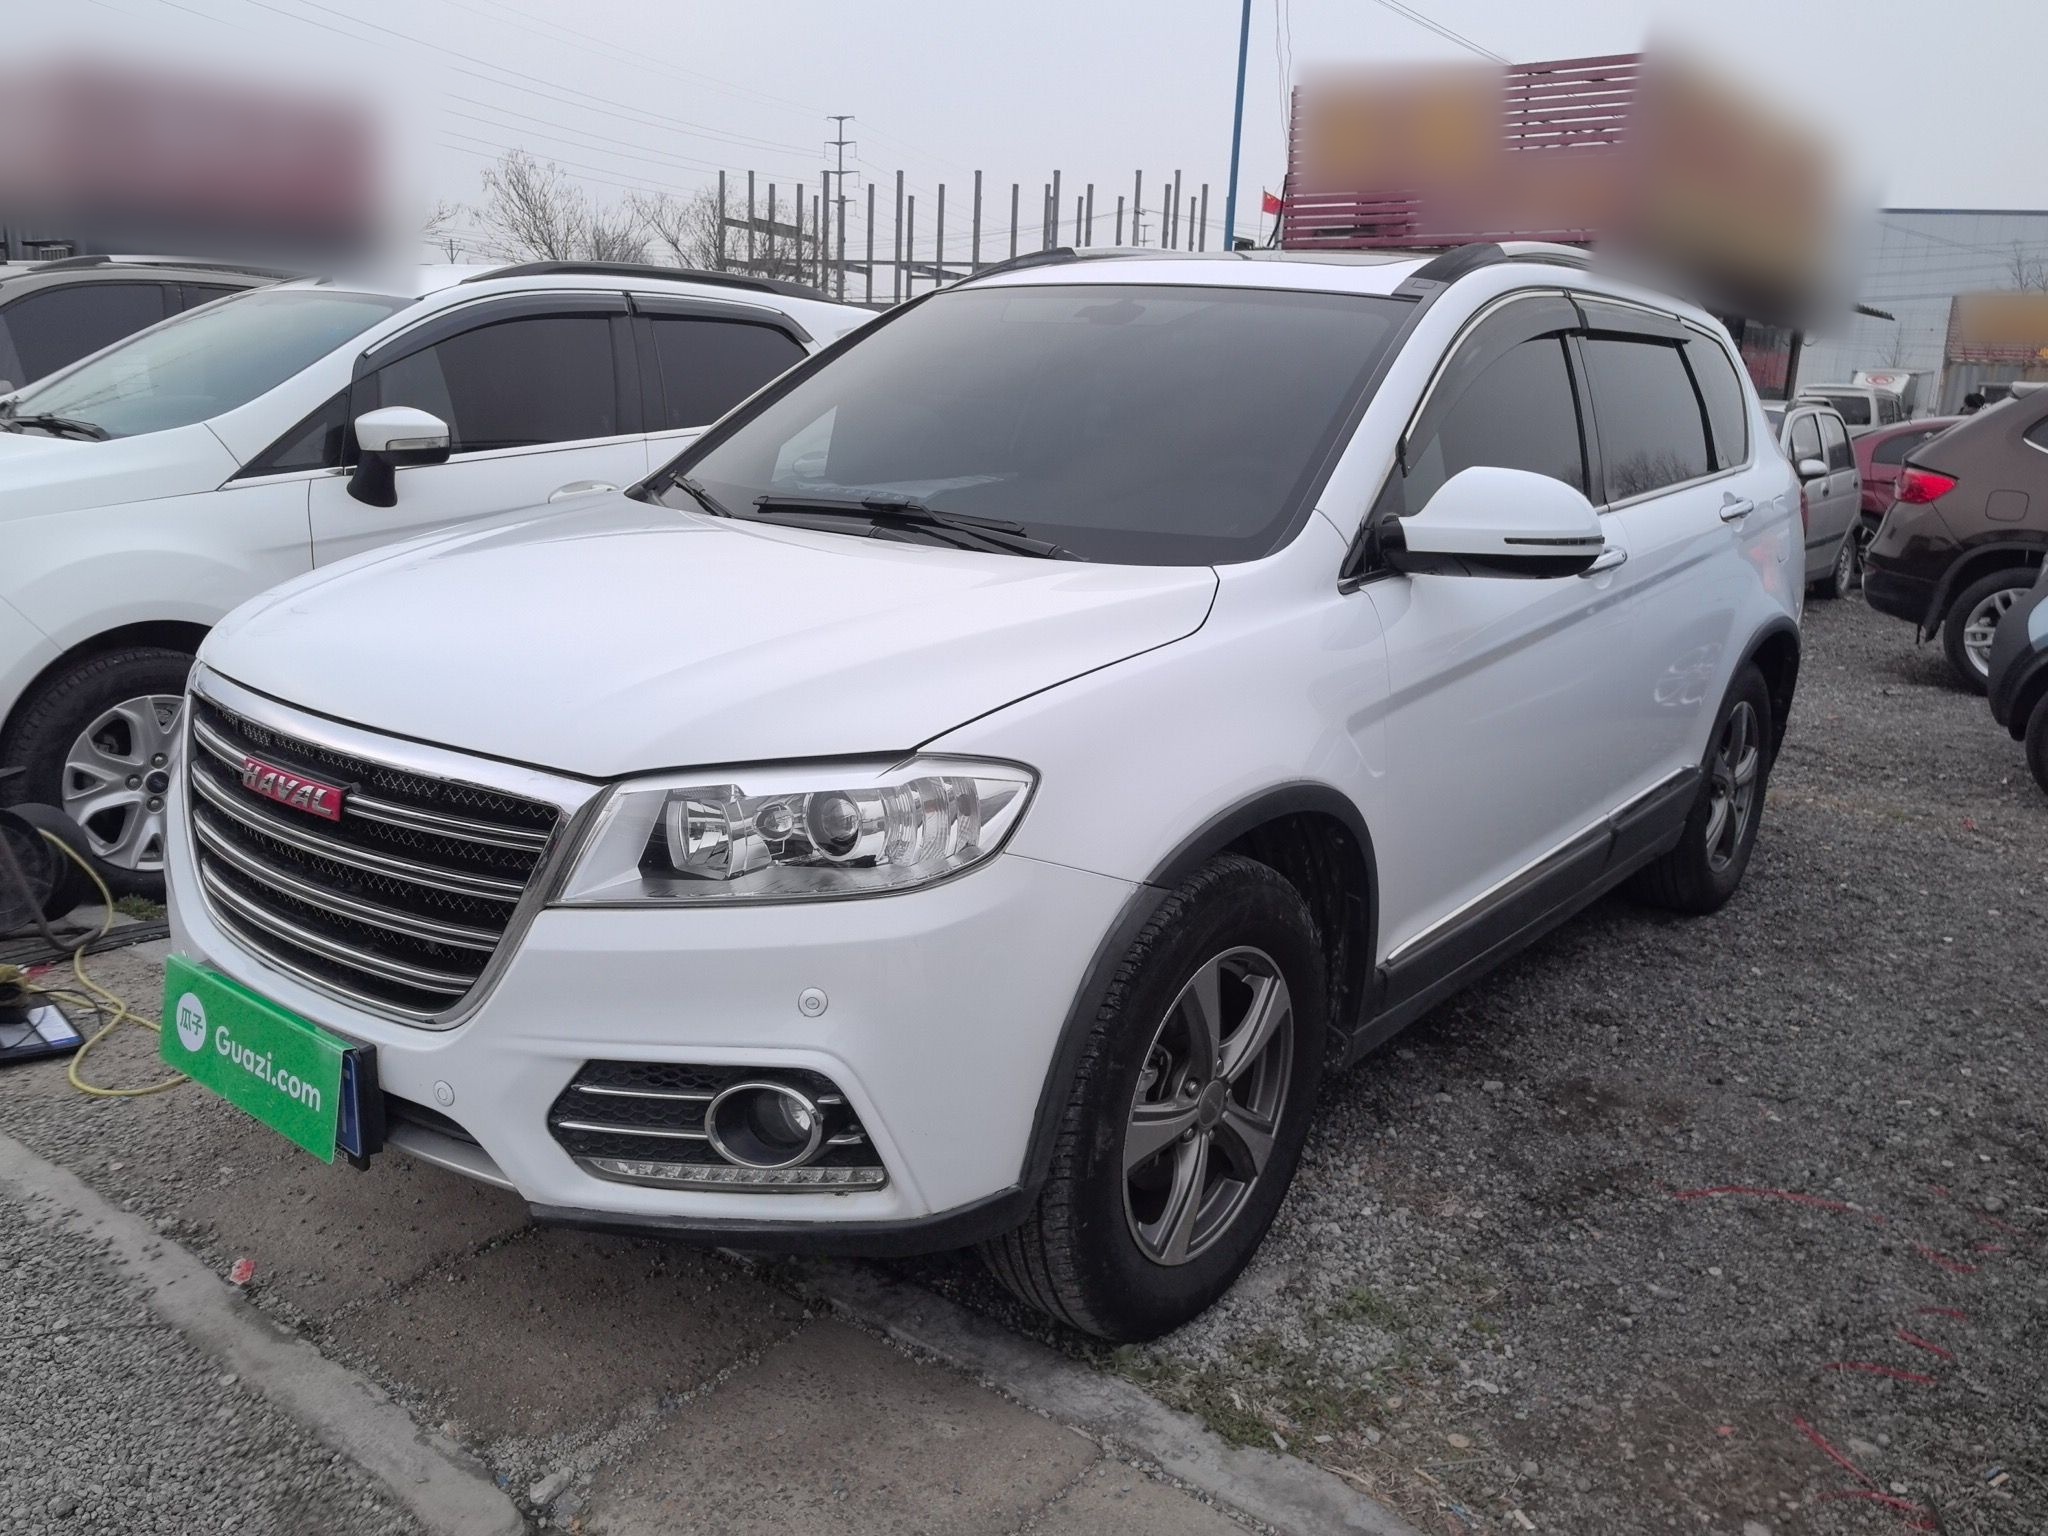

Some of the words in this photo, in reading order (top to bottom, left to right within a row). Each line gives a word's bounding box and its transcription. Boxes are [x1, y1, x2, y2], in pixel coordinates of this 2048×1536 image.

[242, 762, 333, 816] HAVAL
[179, 1006, 203, 1036] 瓜子
[215, 1025, 321, 1113] Guazi.com
